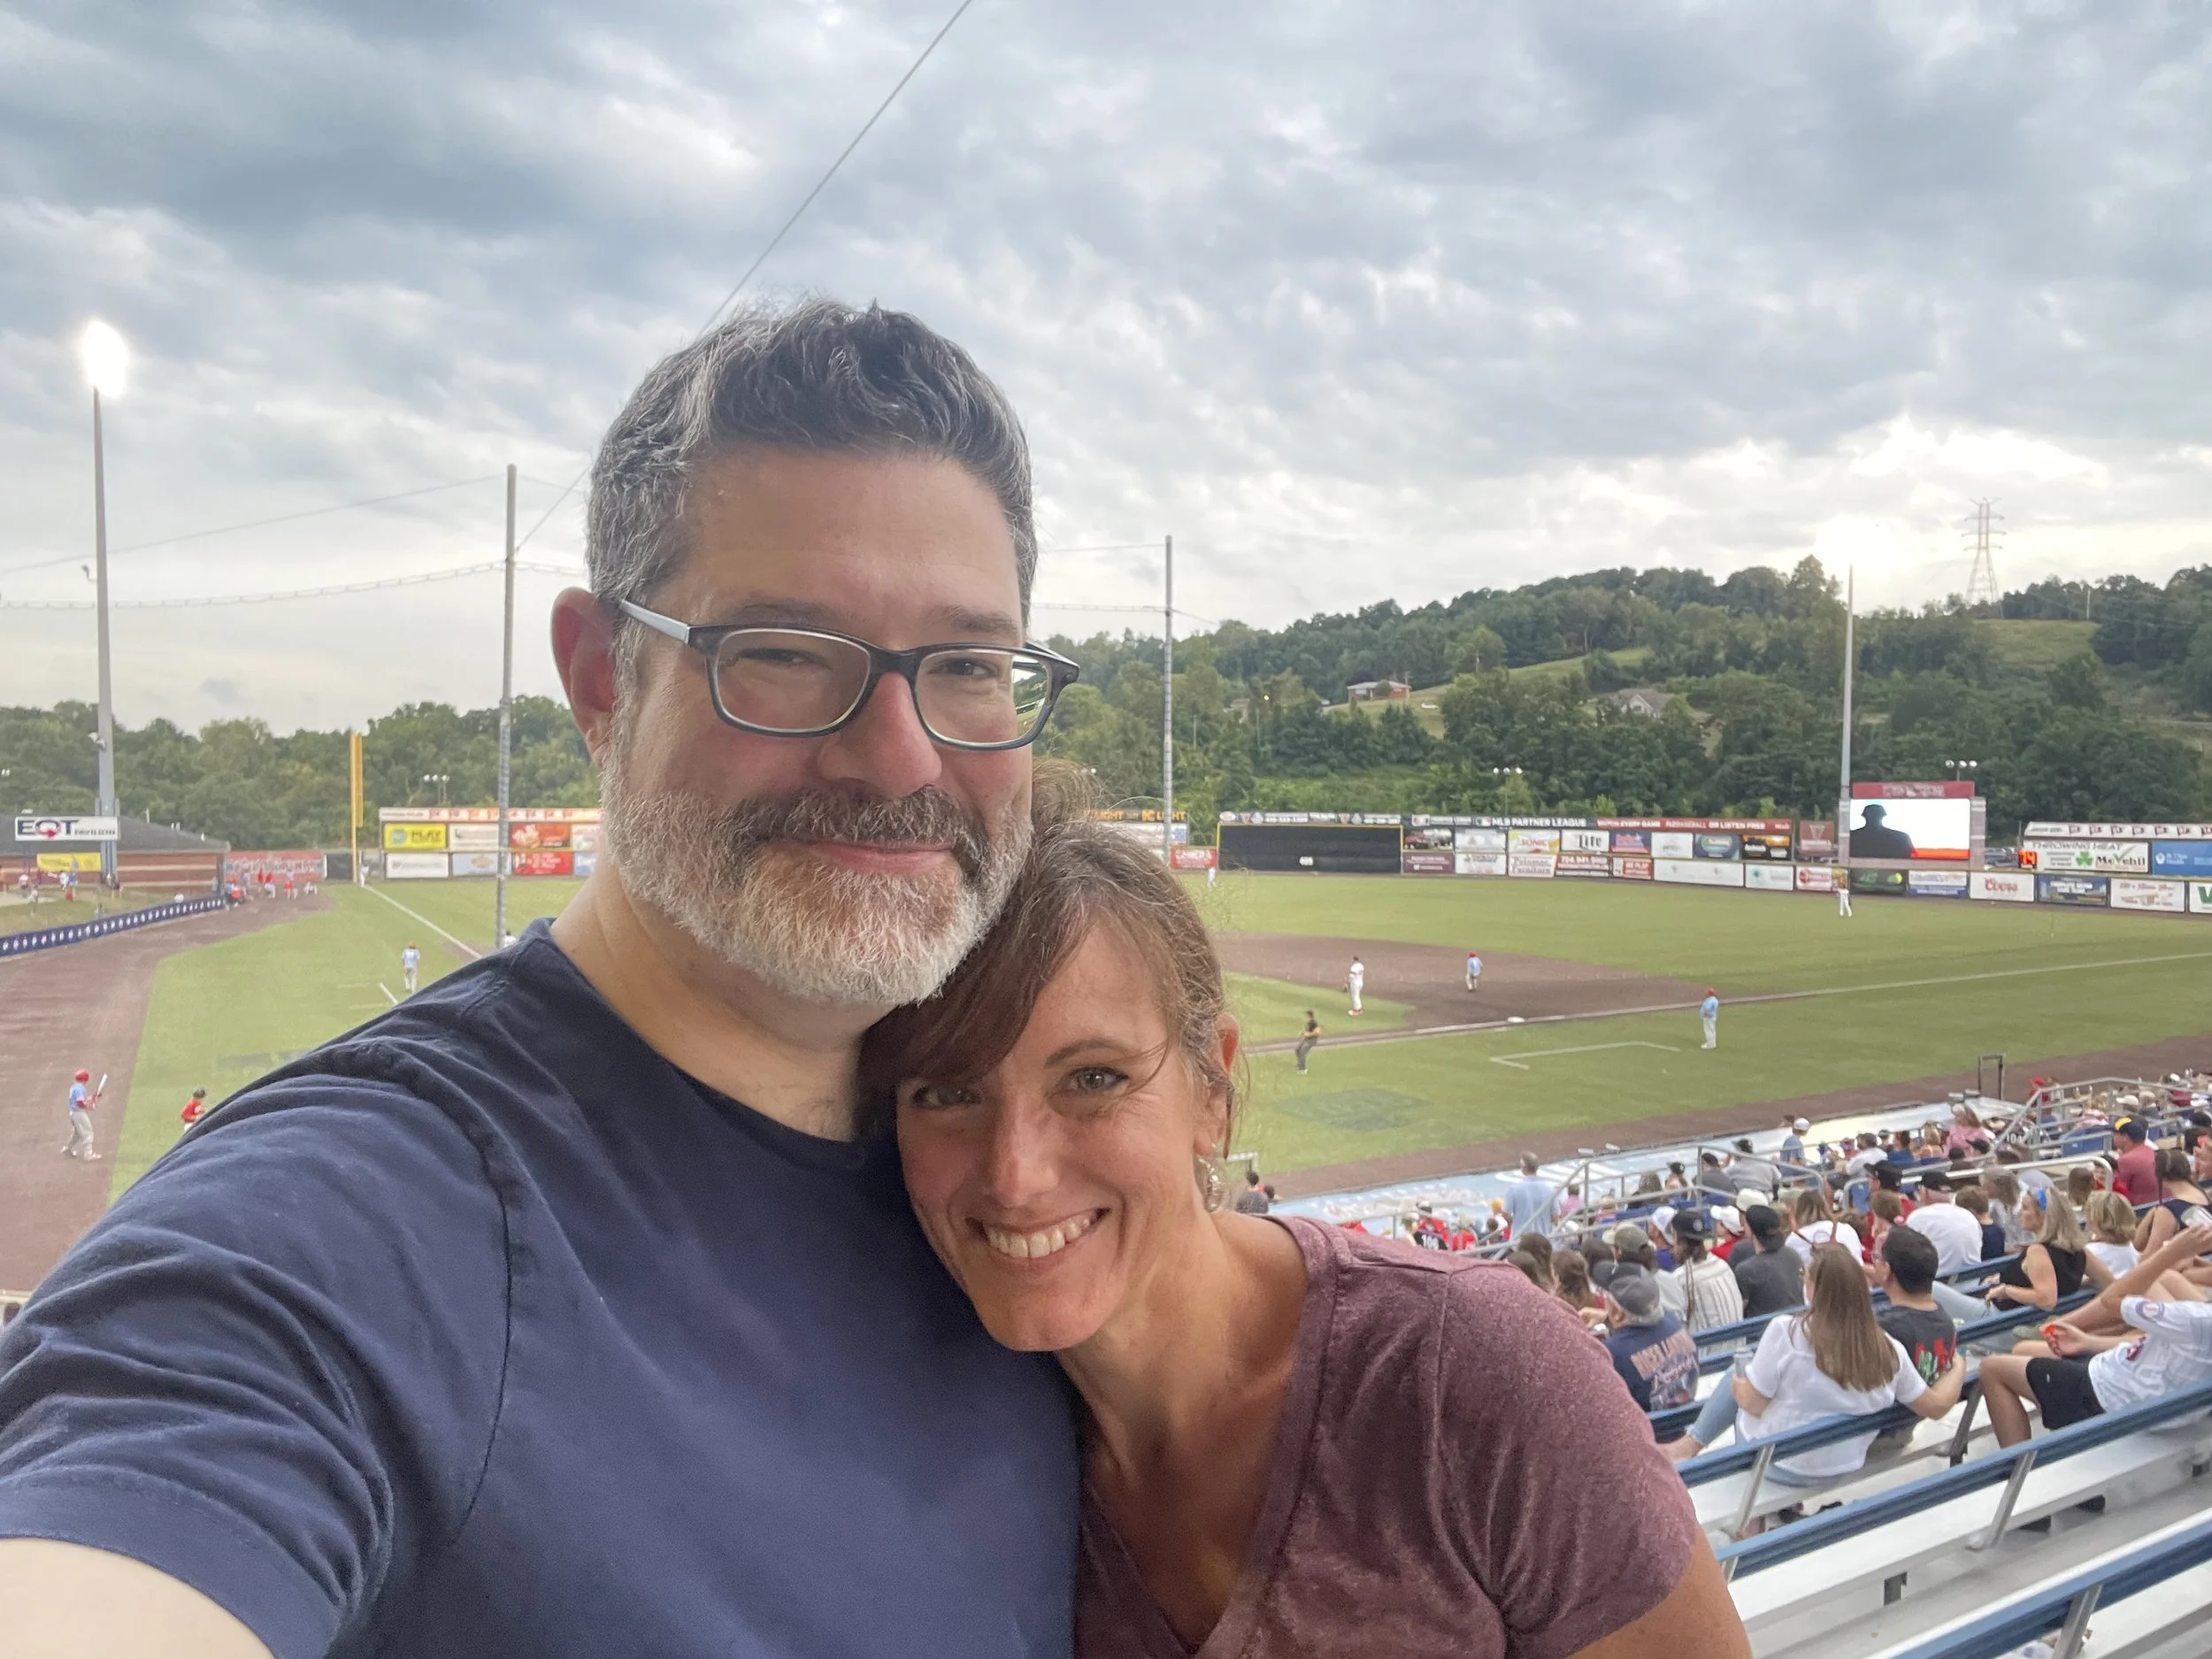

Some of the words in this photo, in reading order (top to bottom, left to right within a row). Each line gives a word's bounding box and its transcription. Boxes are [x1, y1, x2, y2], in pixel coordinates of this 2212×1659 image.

[18, 819, 79, 836] EQT
[1492, 817, 1510, 826] MLB
[1511, 818, 1550, 826] PARTNER
[1551, 818, 1586, 827] LEAGUE
[1578, 833, 1602, 850] Lite
